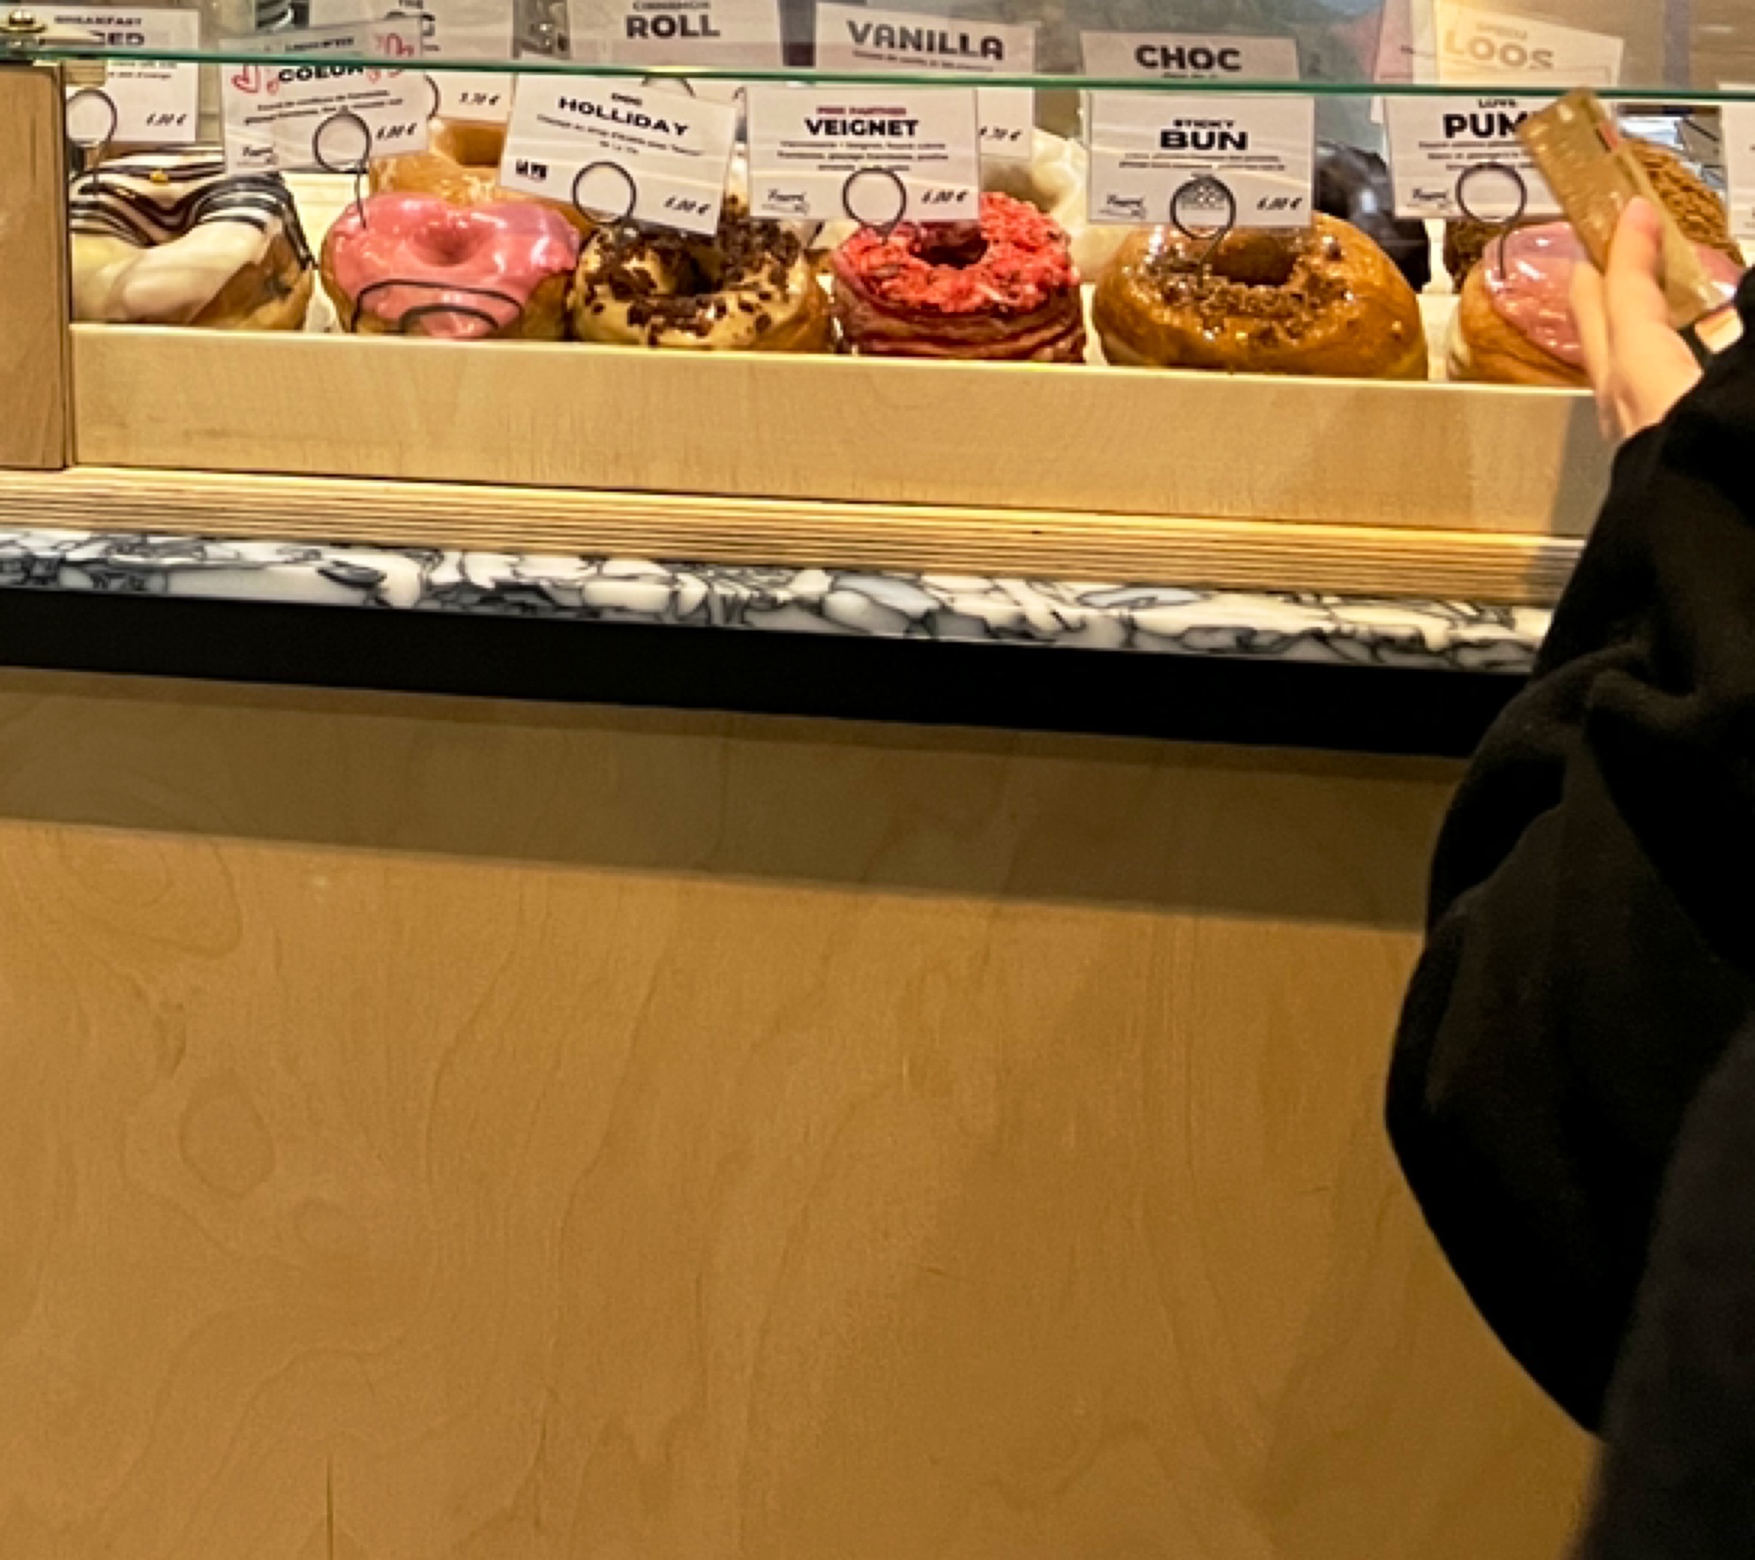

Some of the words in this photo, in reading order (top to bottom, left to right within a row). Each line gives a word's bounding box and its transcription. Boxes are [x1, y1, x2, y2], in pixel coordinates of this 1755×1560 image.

[625, 13, 720, 39] ROLL
[845, 19, 1005, 62] VANILLA
[1443, 29, 1555, 70] LOOS
[1134, 43, 1243, 72] CHOC
[558, 95, 689, 136] HOLLIDAY
[803, 119, 920, 137] VEIGNET
[1443, 112, 1528, 138] PUM
[1160, 130, 1249, 150] BUN
